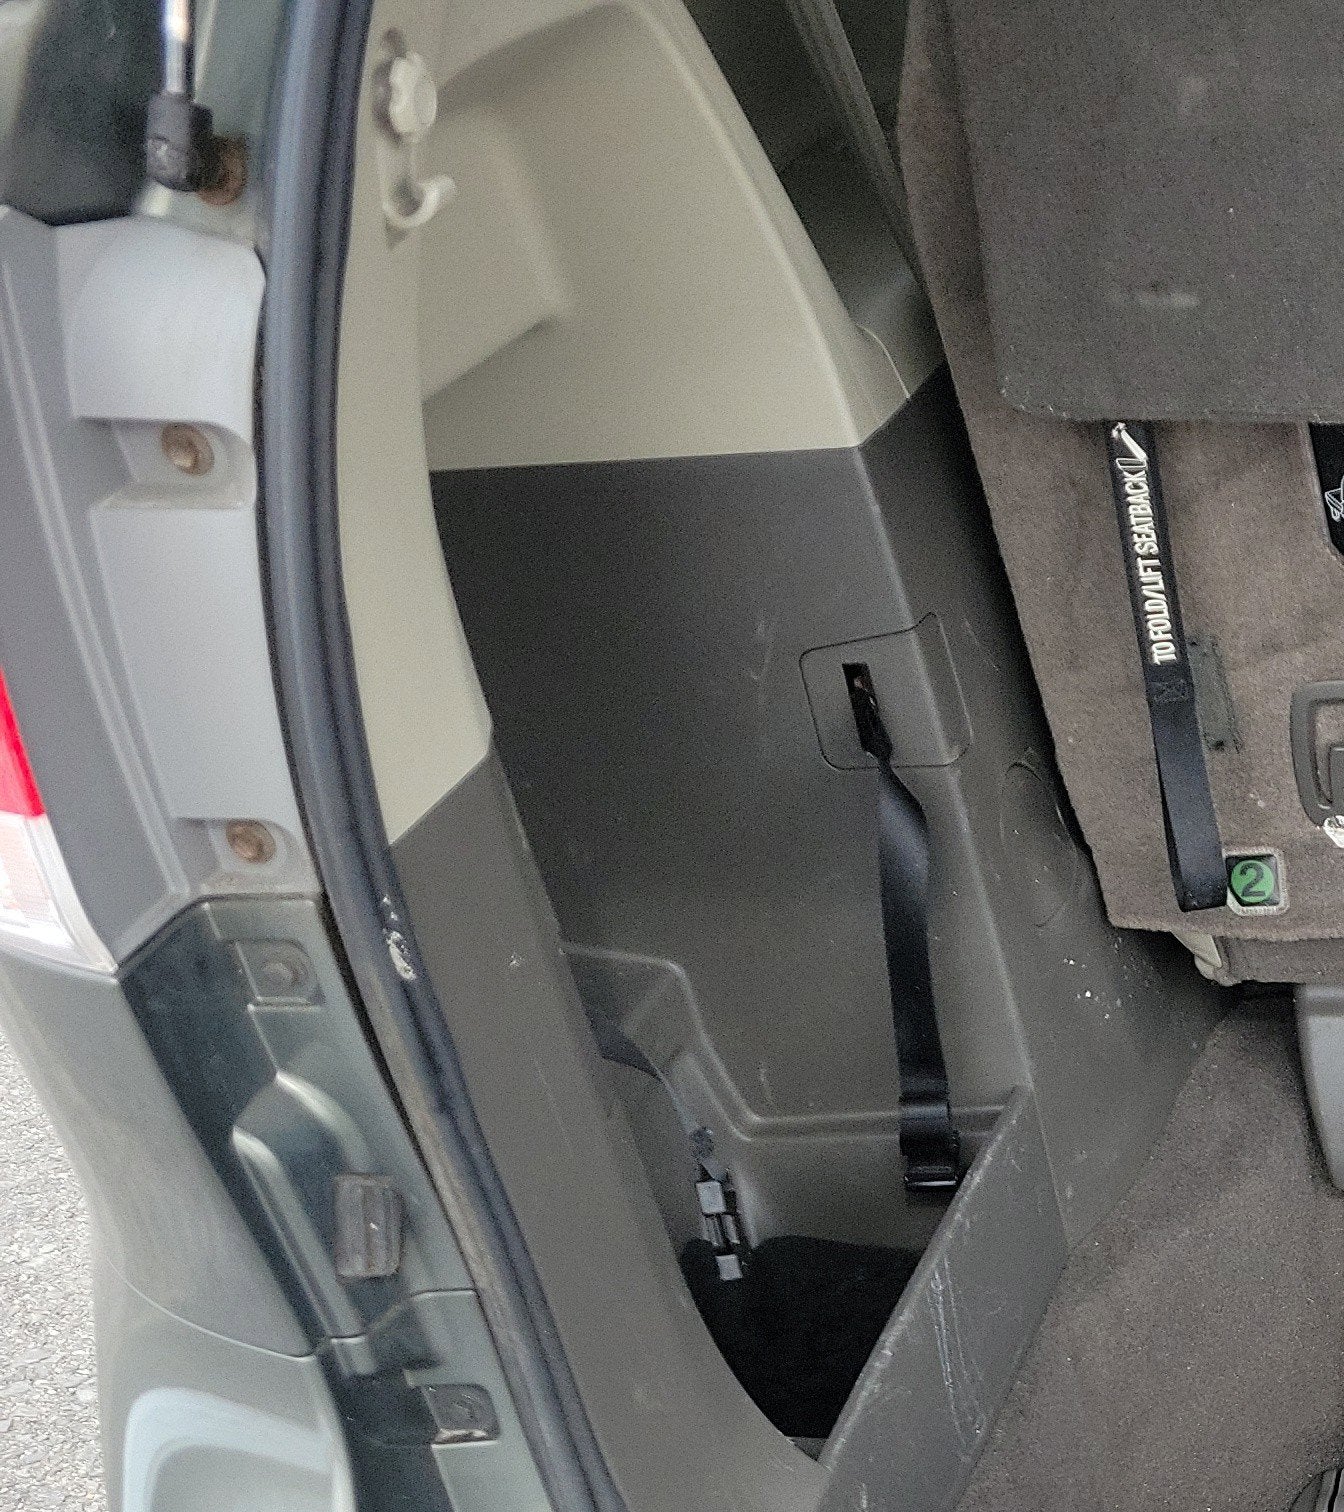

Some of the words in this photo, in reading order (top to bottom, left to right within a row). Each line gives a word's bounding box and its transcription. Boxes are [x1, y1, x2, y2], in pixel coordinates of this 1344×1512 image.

[1123, 470, 1160, 556] SEATBACK
[1137, 557, 1174, 641] FOLD/LIFT
[1152, 641, 1177, 665] TO
[1240, 862, 1266, 897] 2
